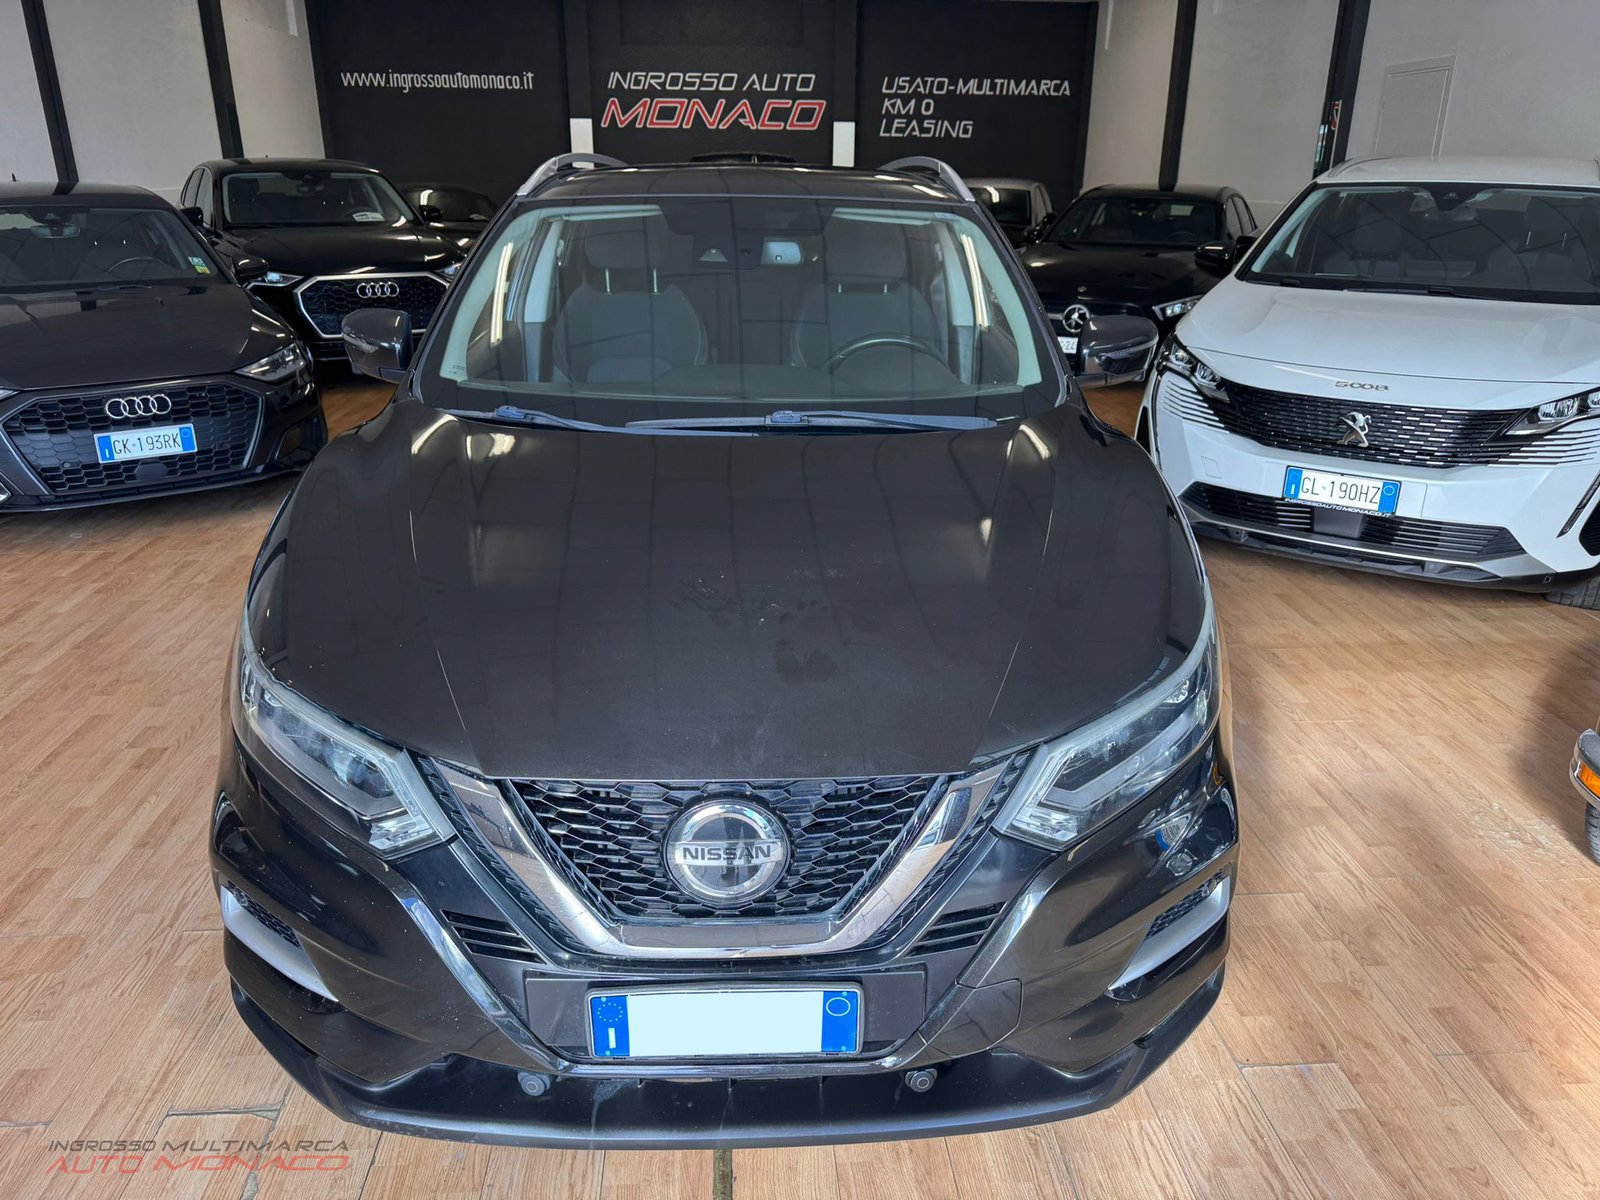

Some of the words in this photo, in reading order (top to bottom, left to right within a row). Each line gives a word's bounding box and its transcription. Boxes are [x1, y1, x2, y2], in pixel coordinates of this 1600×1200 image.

[340, 69, 534, 93] www.ingrossoautomonaco.it
[607, 71, 738, 91] INGROSSO
[742, 73, 816, 92] AUTO
[881, 76, 1071, 96] USATO-MULTIMARCA
[600, 98, 827, 130] MONACO
[881, 98, 916, 115] KM
[879, 118, 974, 138] LEASING
[682, 844, 771, 861] NISSAN
